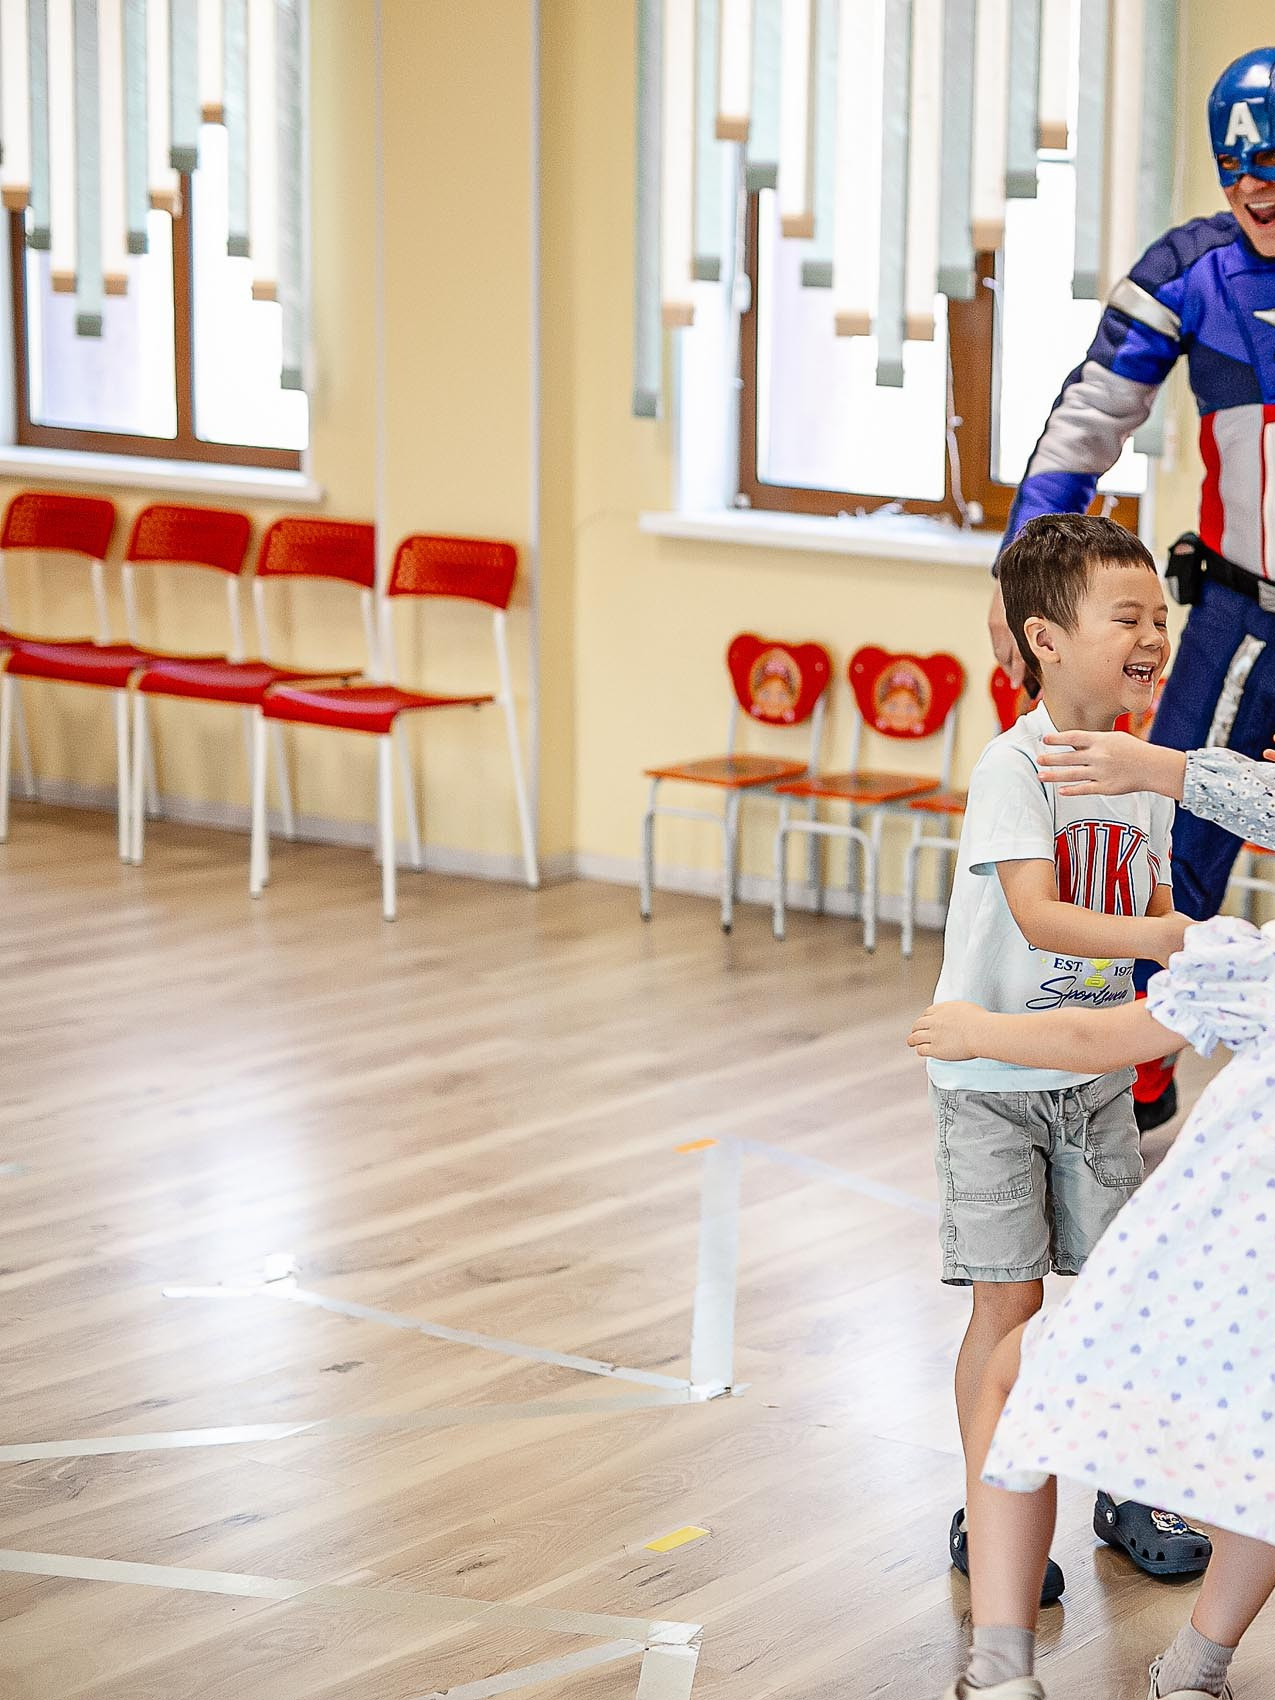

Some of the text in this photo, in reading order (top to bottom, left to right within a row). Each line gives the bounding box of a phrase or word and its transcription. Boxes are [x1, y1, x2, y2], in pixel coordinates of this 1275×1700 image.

[1223, 101, 1261, 147] A
[1053, 957, 1133, 977] EST. 197
